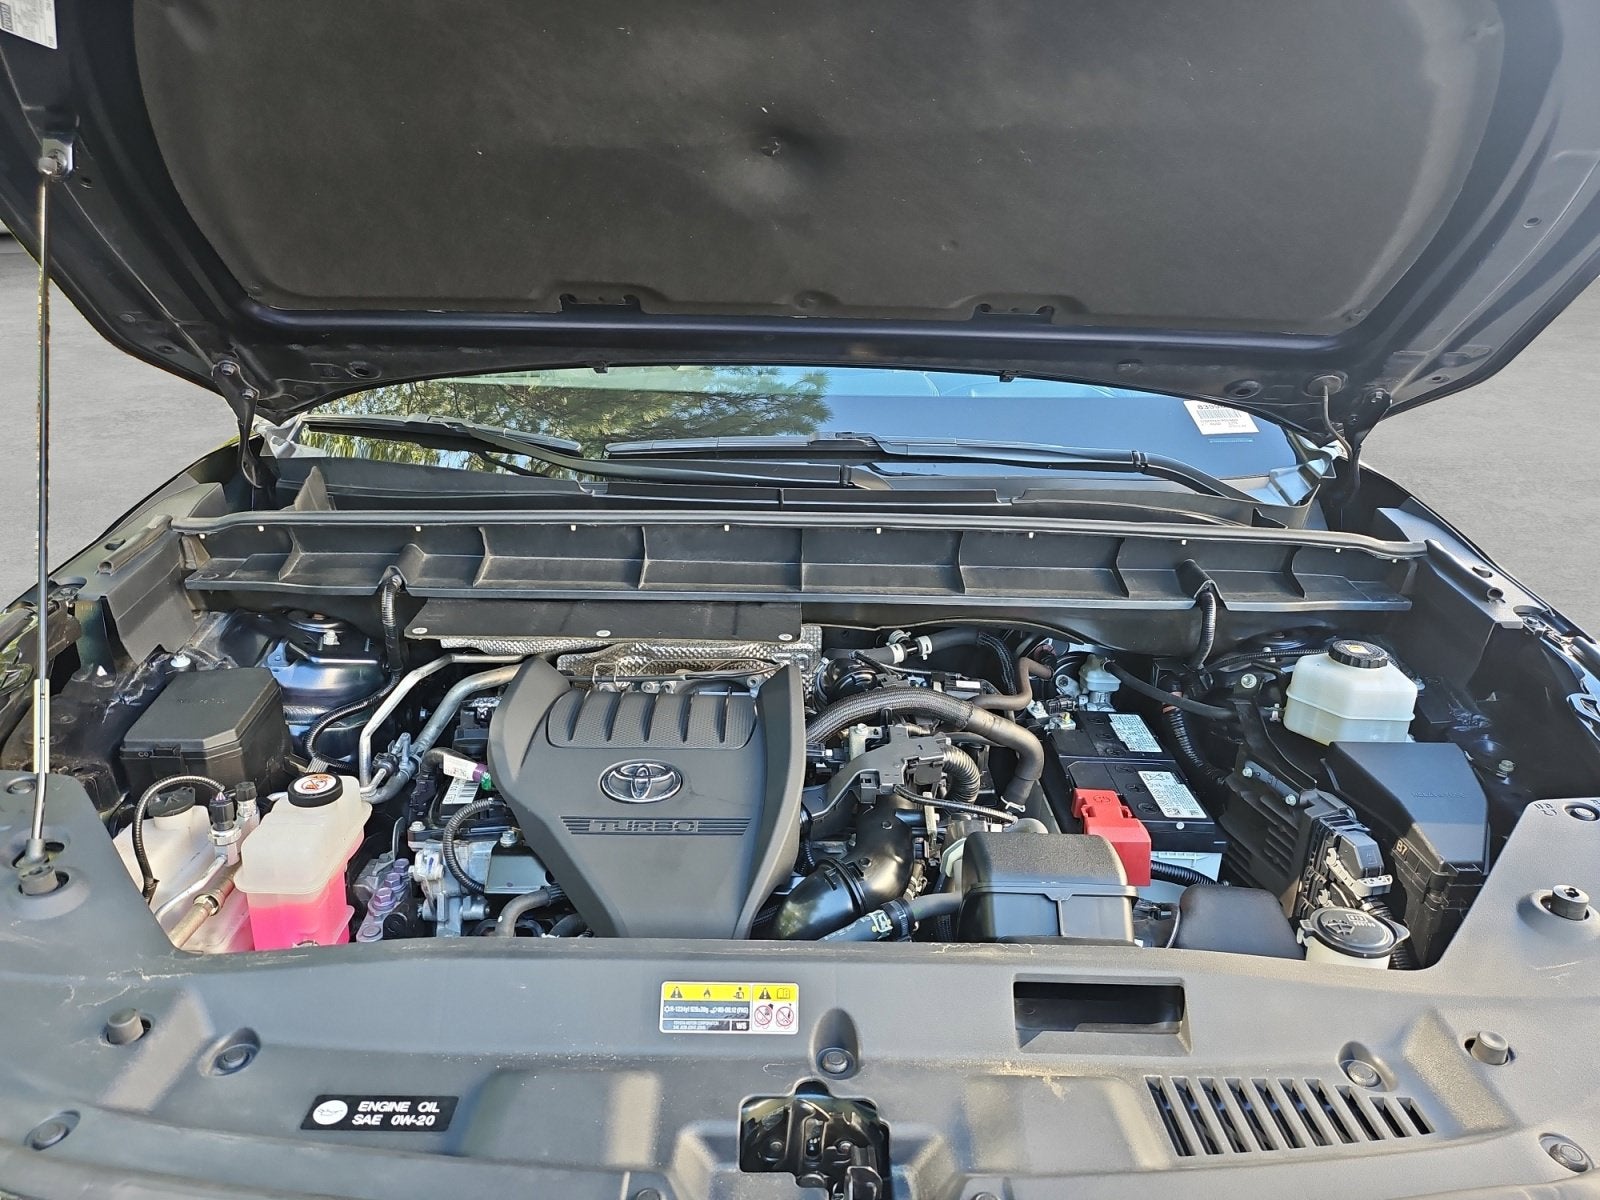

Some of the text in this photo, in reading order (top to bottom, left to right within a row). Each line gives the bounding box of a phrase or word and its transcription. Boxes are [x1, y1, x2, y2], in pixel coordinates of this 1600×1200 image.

[594, 820, 695, 832] TURBO
[1396, 839, 1408, 855] B7
[357, 1101, 440, 1113] ENGINE OIL
[351, 1114, 435, 1126] SAE 0W-20
